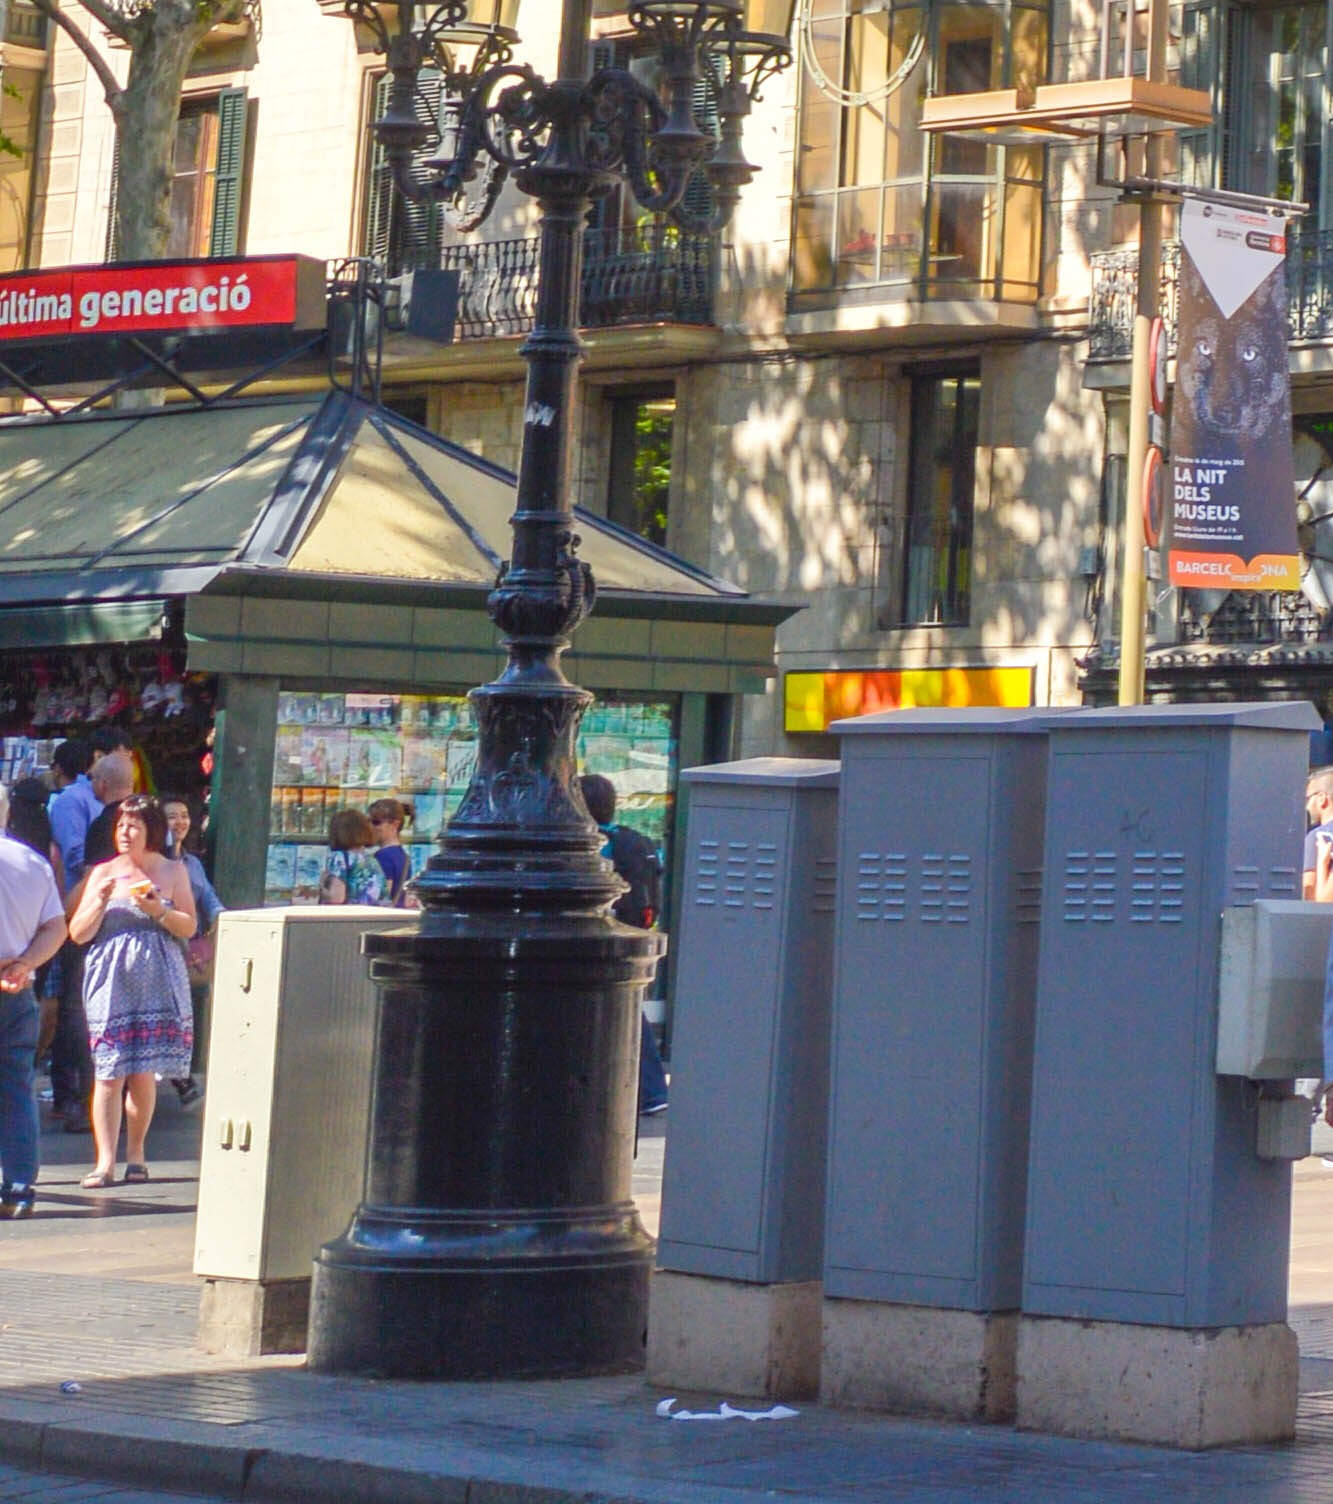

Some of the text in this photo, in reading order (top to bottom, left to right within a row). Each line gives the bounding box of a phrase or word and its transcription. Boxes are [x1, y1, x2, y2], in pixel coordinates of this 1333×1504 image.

[0, 273, 251, 328] última generació
[1174, 467, 1227, 484] LA NIT
[1174, 485, 1211, 502] DELS
[1174, 503, 1240, 521] MUSEUS
